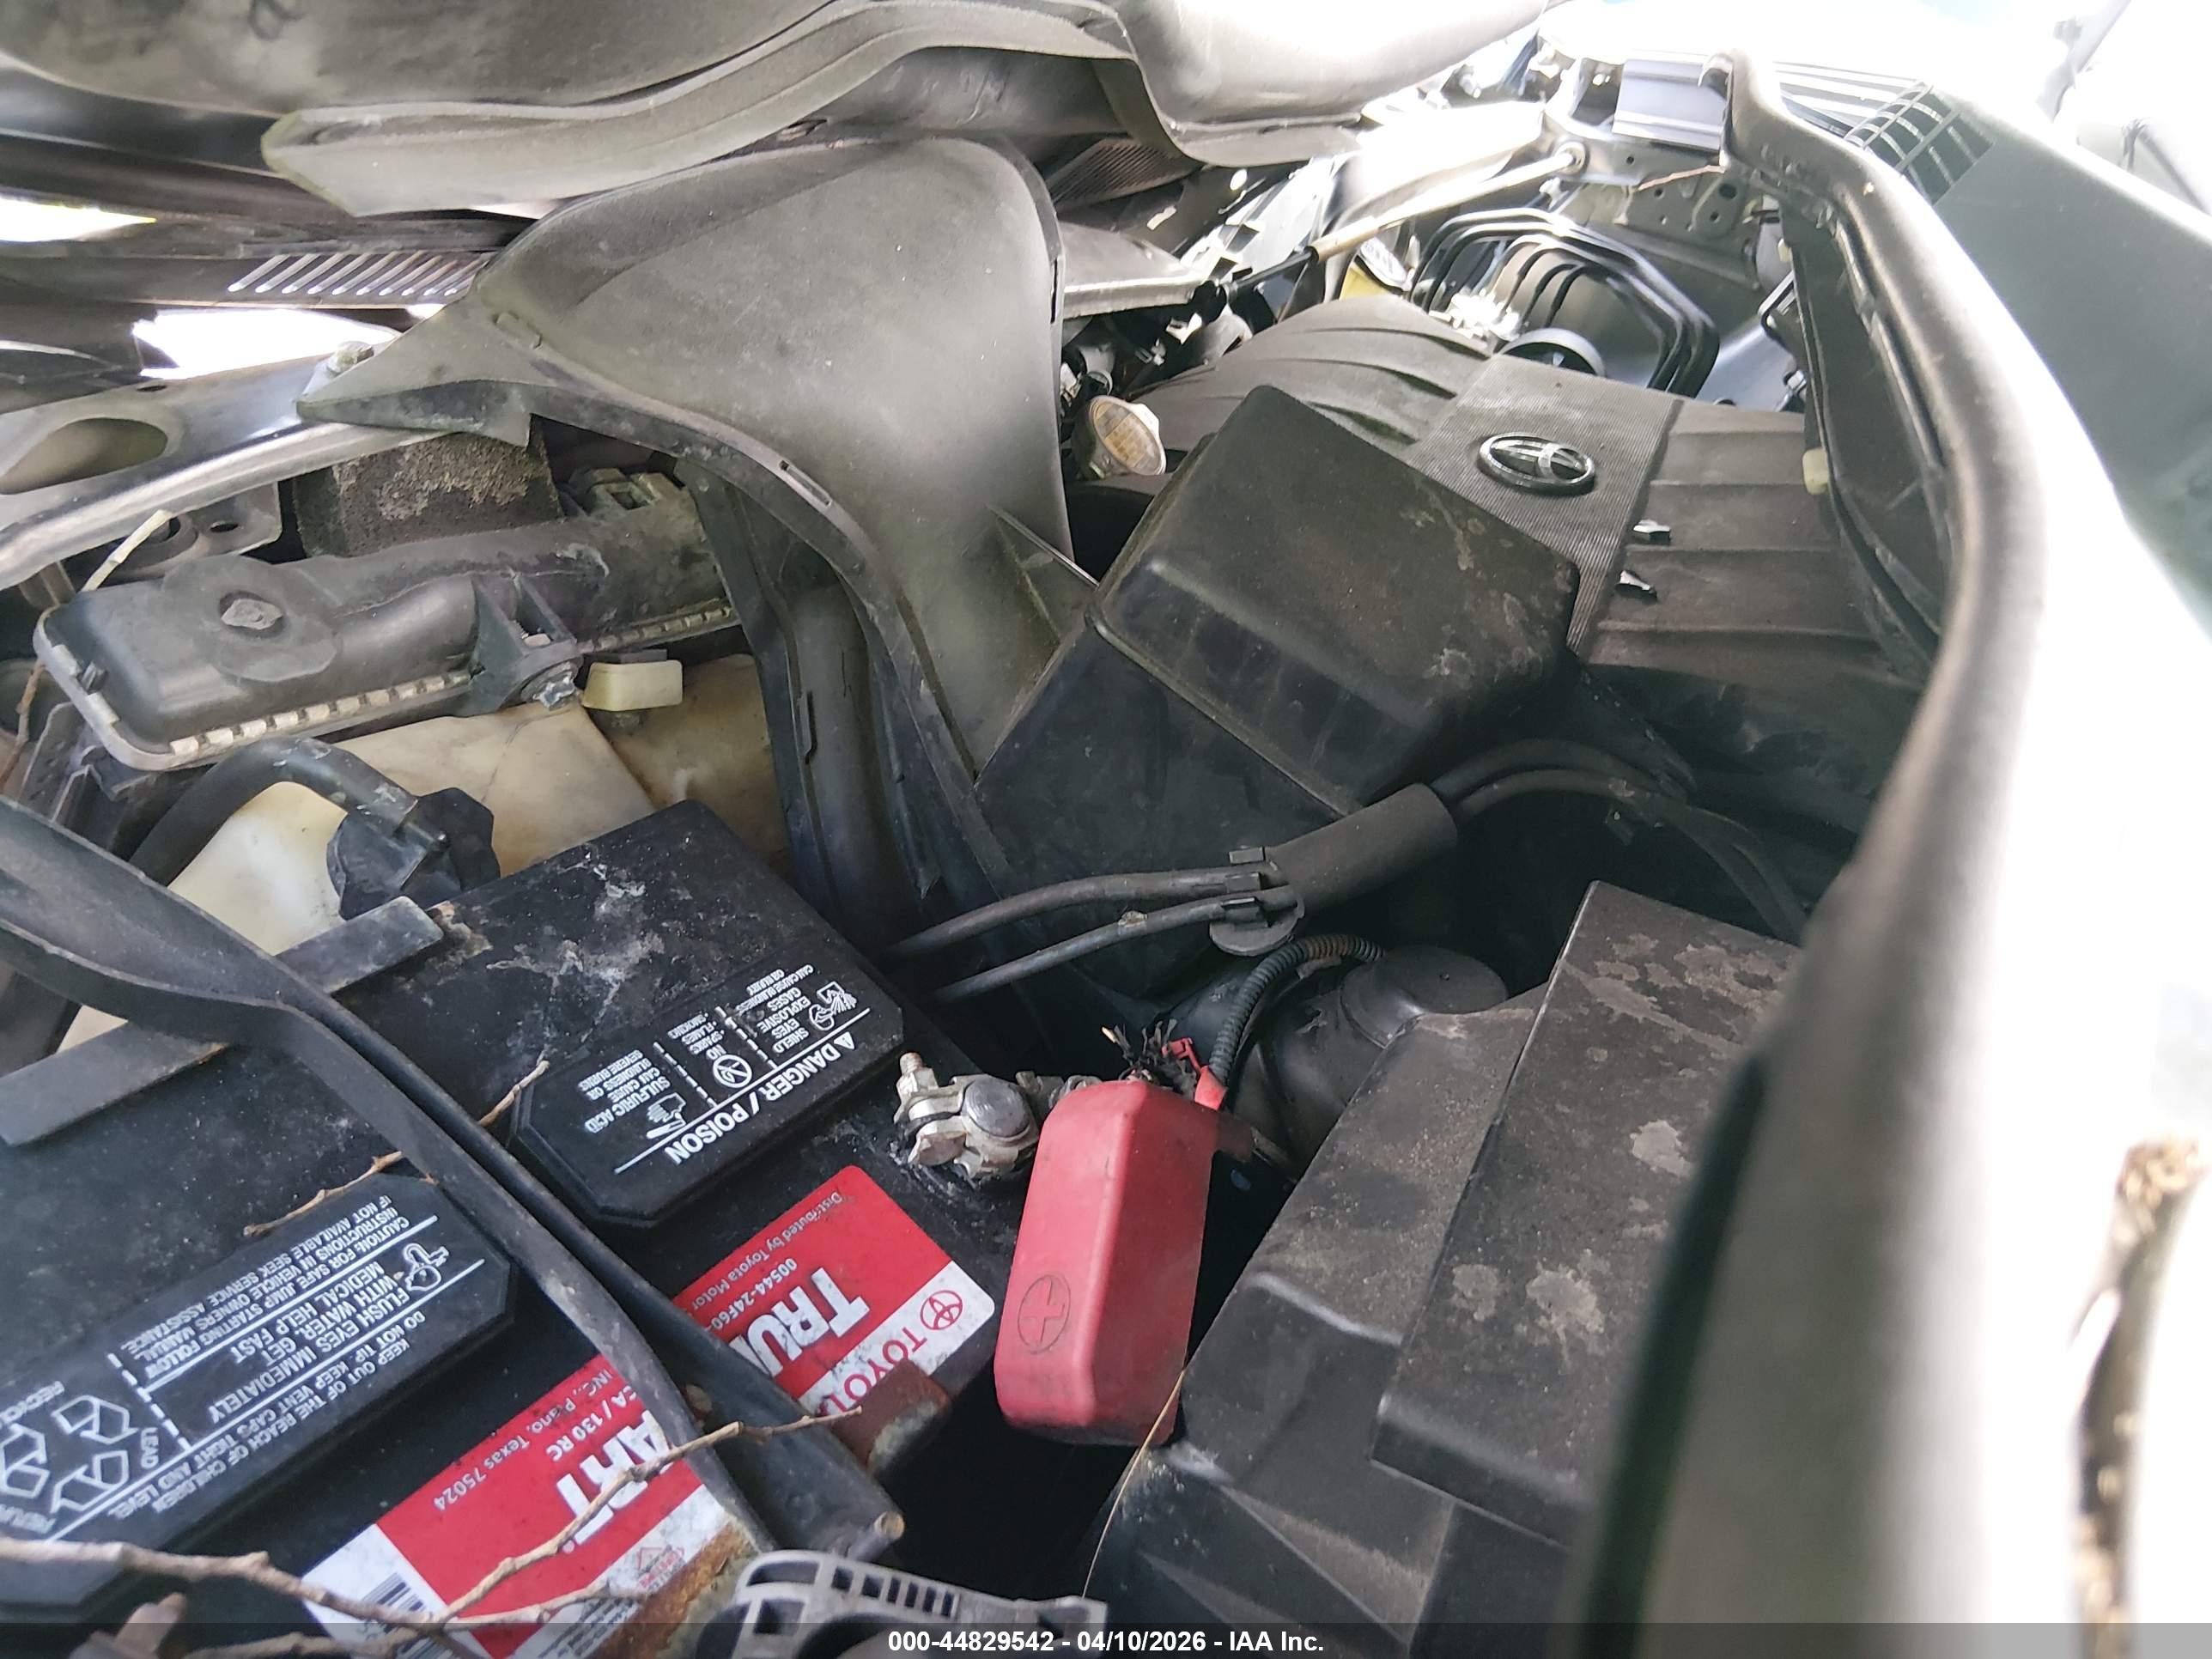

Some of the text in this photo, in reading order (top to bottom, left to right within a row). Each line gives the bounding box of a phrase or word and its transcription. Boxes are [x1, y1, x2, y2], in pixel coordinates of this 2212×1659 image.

[773, 971, 801, 993] CAUSE
[757, 996, 811, 1033] EXPLOSIVE
[768, 988, 801, 1011] GASES
[682, 1023, 714, 1044] FLAMES
[690, 1031, 722, 1054] SPARKS
[772, 1018, 799, 1038] EYES
[773, 1028, 808, 1053] SHIELD
[707, 1045, 726, 1060] NO
[579, 1050, 642, 1091] SEVERE BURNS
[586, 1058, 651, 1099] BLINDNESS OR
[608, 1067, 659, 1103] CAN CAUSE
[585, 1077, 670, 1133] SULFURIC ACID
[665, 1042, 841, 1164] DANGER / POISON
[316, 1204, 398, 1261] INSTRUCTIONS
[782, 1192, 842, 1242] Distributed
[767, 1237, 784, 1250] by
[121, 1195, 392, 1359] IF NOT AVAILABLE SEEK SERVICE ASSISTANCE.
[300, 1255, 316, 1270] IN
[728, 1250, 769, 1280] Toyota
[250, 1261, 301, 1299] VEHICLE
[693, 1279, 730, 1309] Motor
[145, 1217, 409, 1382] CAUTION: FOR SAFE JUMP STARTING FOLLOW
[196, 1290, 250, 1335] OWNERS
[231, 1261, 384, 1363] MEDICAL HELP FAST
[261, 1276, 398, 1365] WITH WATER. GET
[404, 1311, 425, 1328] DO
[376, 1325, 404, 1349] NOT
[209, 1288, 410, 1423] FLUSH EYES IMMEDIATELY
[315, 1362, 349, 1389] KEEP
[816, 1328, 928, 1417] TOYOT
[278, 1386, 313, 1413] VENT
[152, 1339, 409, 1512] KEEP OUT OF THE REACH OF CHILDREN
[237, 1409, 276, 1437] CAPS
[573, 1413, 602, 1440] 130
[141, 1427, 159, 1468] LEAD
[194, 1435, 237, 1469] TIGHT
[484, 1436, 529, 1468] Texas
[547, 1436, 574, 1461] RC
[158, 1462, 191, 1490] AND
[434, 1468, 486, 1510] 75024
[108, 1485, 159, 1517] LEVEL
